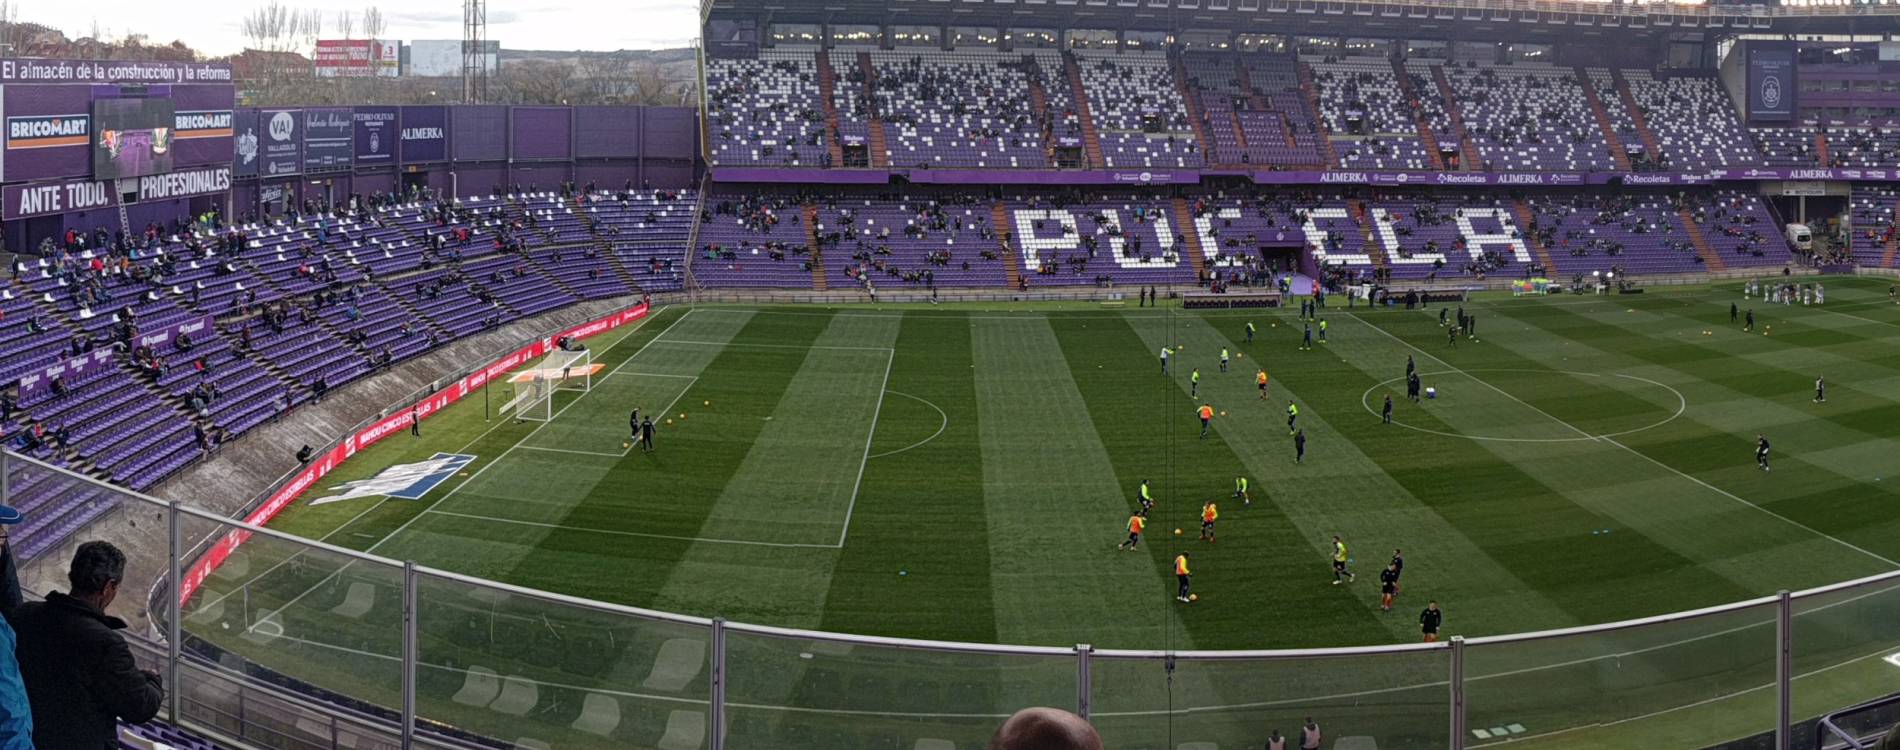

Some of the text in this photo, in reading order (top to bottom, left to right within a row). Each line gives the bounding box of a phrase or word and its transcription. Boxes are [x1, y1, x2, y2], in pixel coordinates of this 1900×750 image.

[3, 61, 231, 83] El almacén de la construcción y la reforma
[11, 119, 87, 138] BRICOMART
[175, 114, 231, 130] BRICOMART
[401, 127, 444, 140] ALIMERKA
[1320, 173, 1368, 183] ALIMERKA
[1446, 174, 1486, 183] Recoletas
[1497, 174, 1543, 184] ALIMERKA
[1633, 175, 1670, 183] Recoletas
[1789, 169, 1833, 179] ALIMERKA
[141, 168, 230, 200] PROFESIONALES
[19, 181, 109, 215] ANTE TODO,
[360, 403, 431, 444] MAHOU CINCO ESTLLAS
